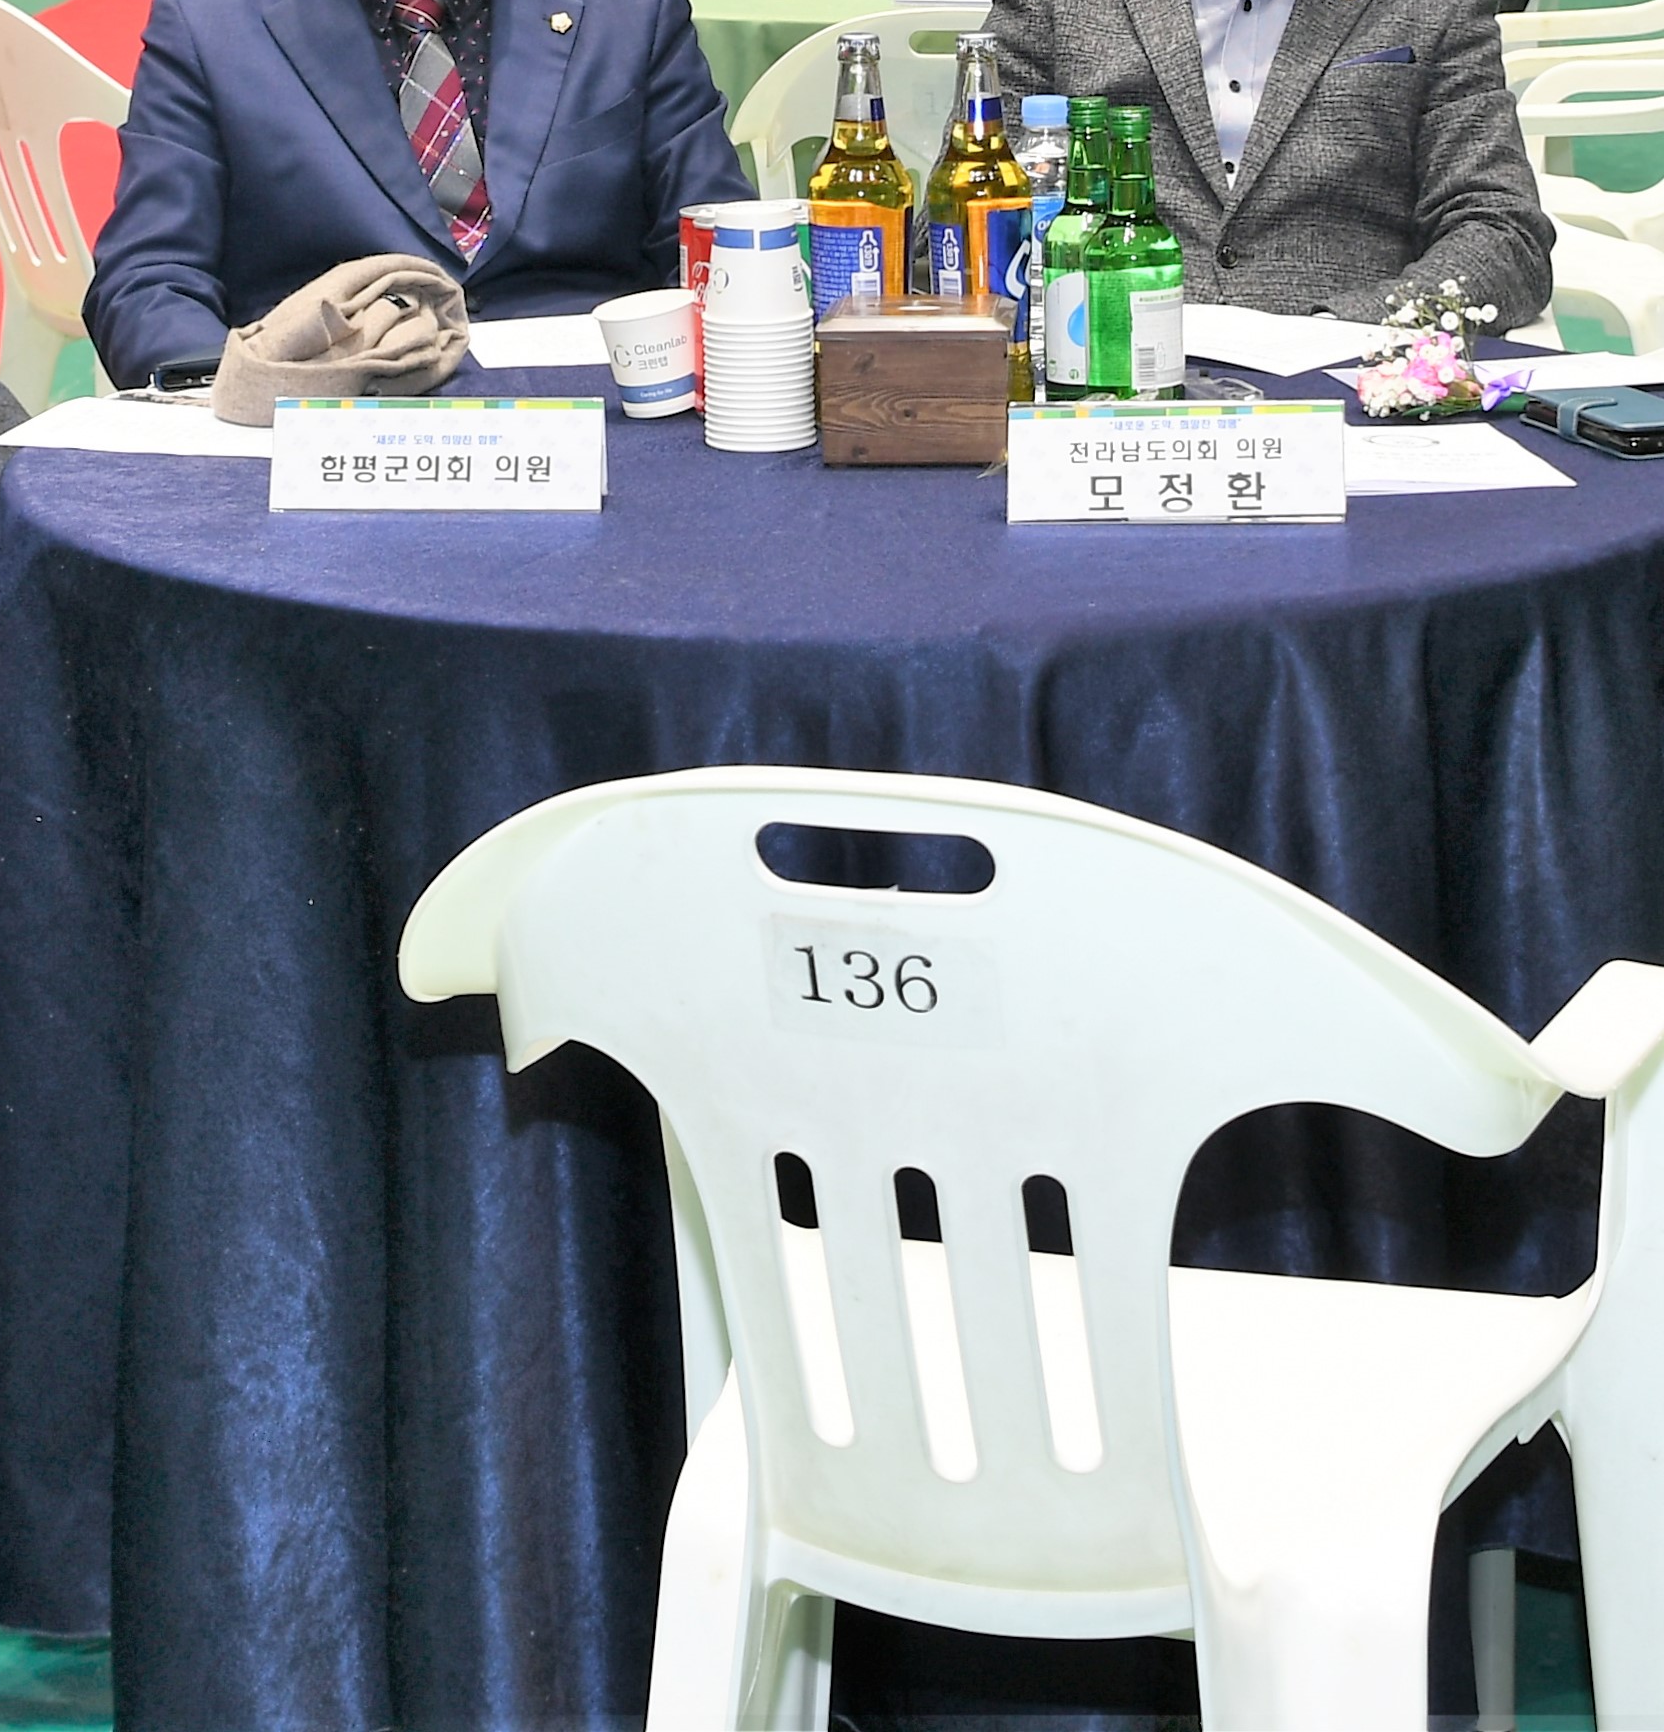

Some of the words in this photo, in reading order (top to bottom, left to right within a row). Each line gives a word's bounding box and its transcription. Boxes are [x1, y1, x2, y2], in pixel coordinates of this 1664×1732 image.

[634, 335, 687, 356] Cleanlab
[1069, 438, 1218, 464] 전라남도의회
[1236, 437, 1283, 460] 의원
[320, 455, 472, 483] 함평군의회
[495, 455, 552, 483] 의원
[794, 945, 938, 1013] 136
